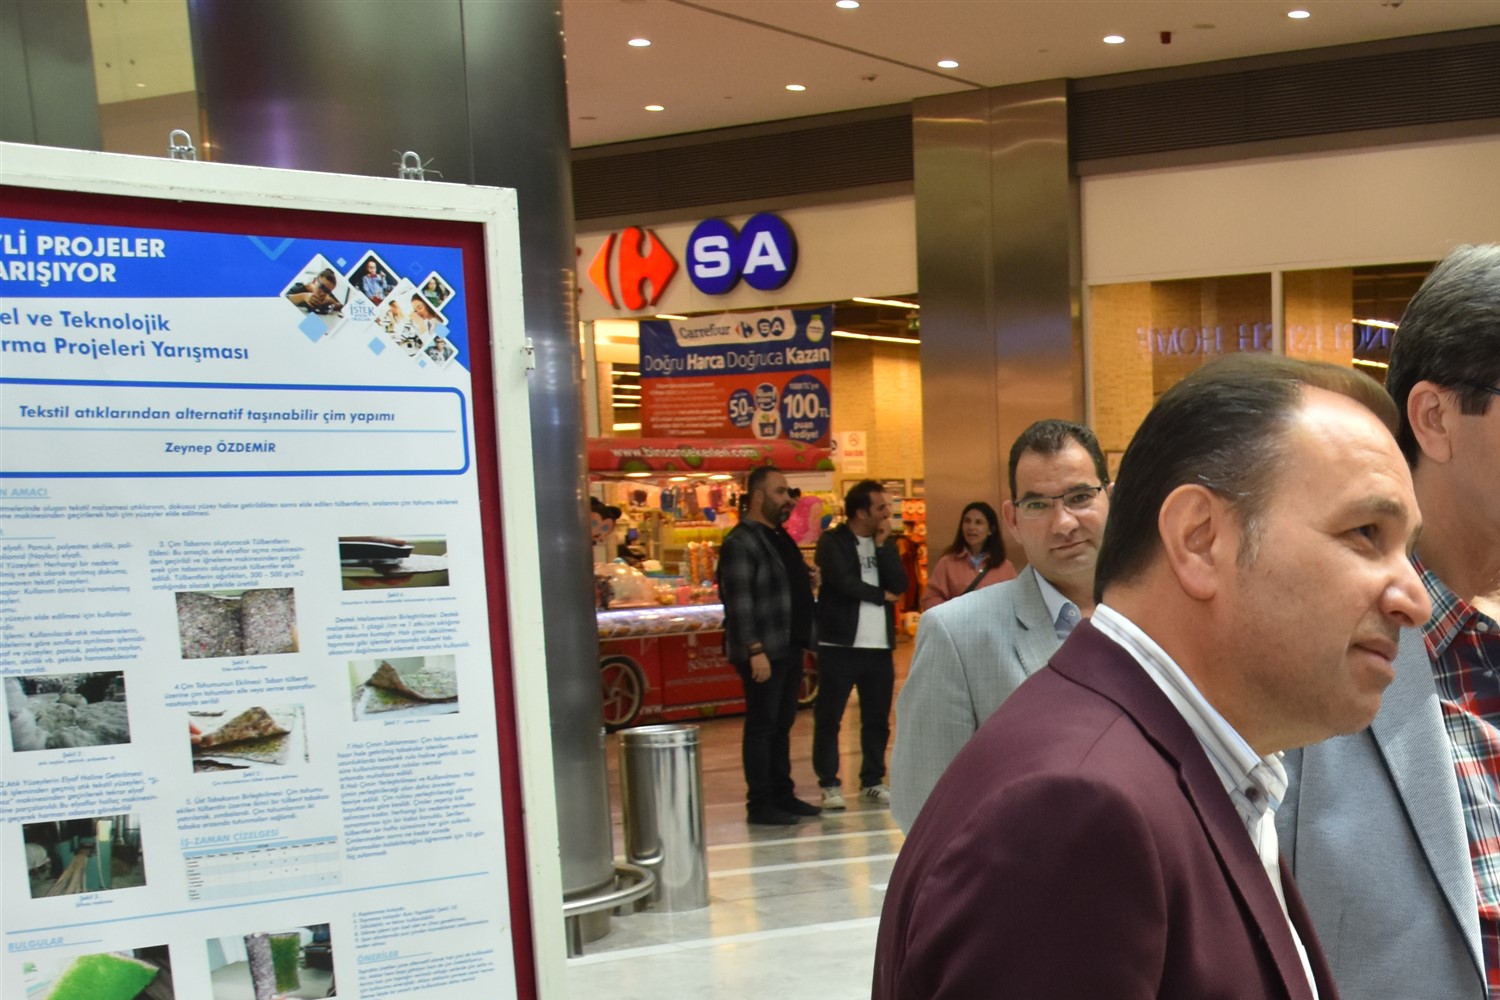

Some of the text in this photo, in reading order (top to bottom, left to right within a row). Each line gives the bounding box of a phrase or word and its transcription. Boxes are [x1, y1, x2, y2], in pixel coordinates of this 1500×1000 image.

[37, 235, 166, 258] PROJELER
[693, 231, 786, 278] SA
[26, 314, 53, 327] ve
[59, 310, 170, 334] Teknolojik
[678, 323, 731, 339] Carrefour
[54, 337, 145, 359] Projeleri
[151, 341, 249, 363] Yarışması
[644, 347, 830, 374] Doğru Harca Doğruca Kazan
[19, 405, 395, 424] Tekstil atıklarından alternatif taşınabilir çim yapımı
[165, 440, 276, 455] Zeynep ÖZDEMİR
[8, 936, 65, 951] BULGULAR
